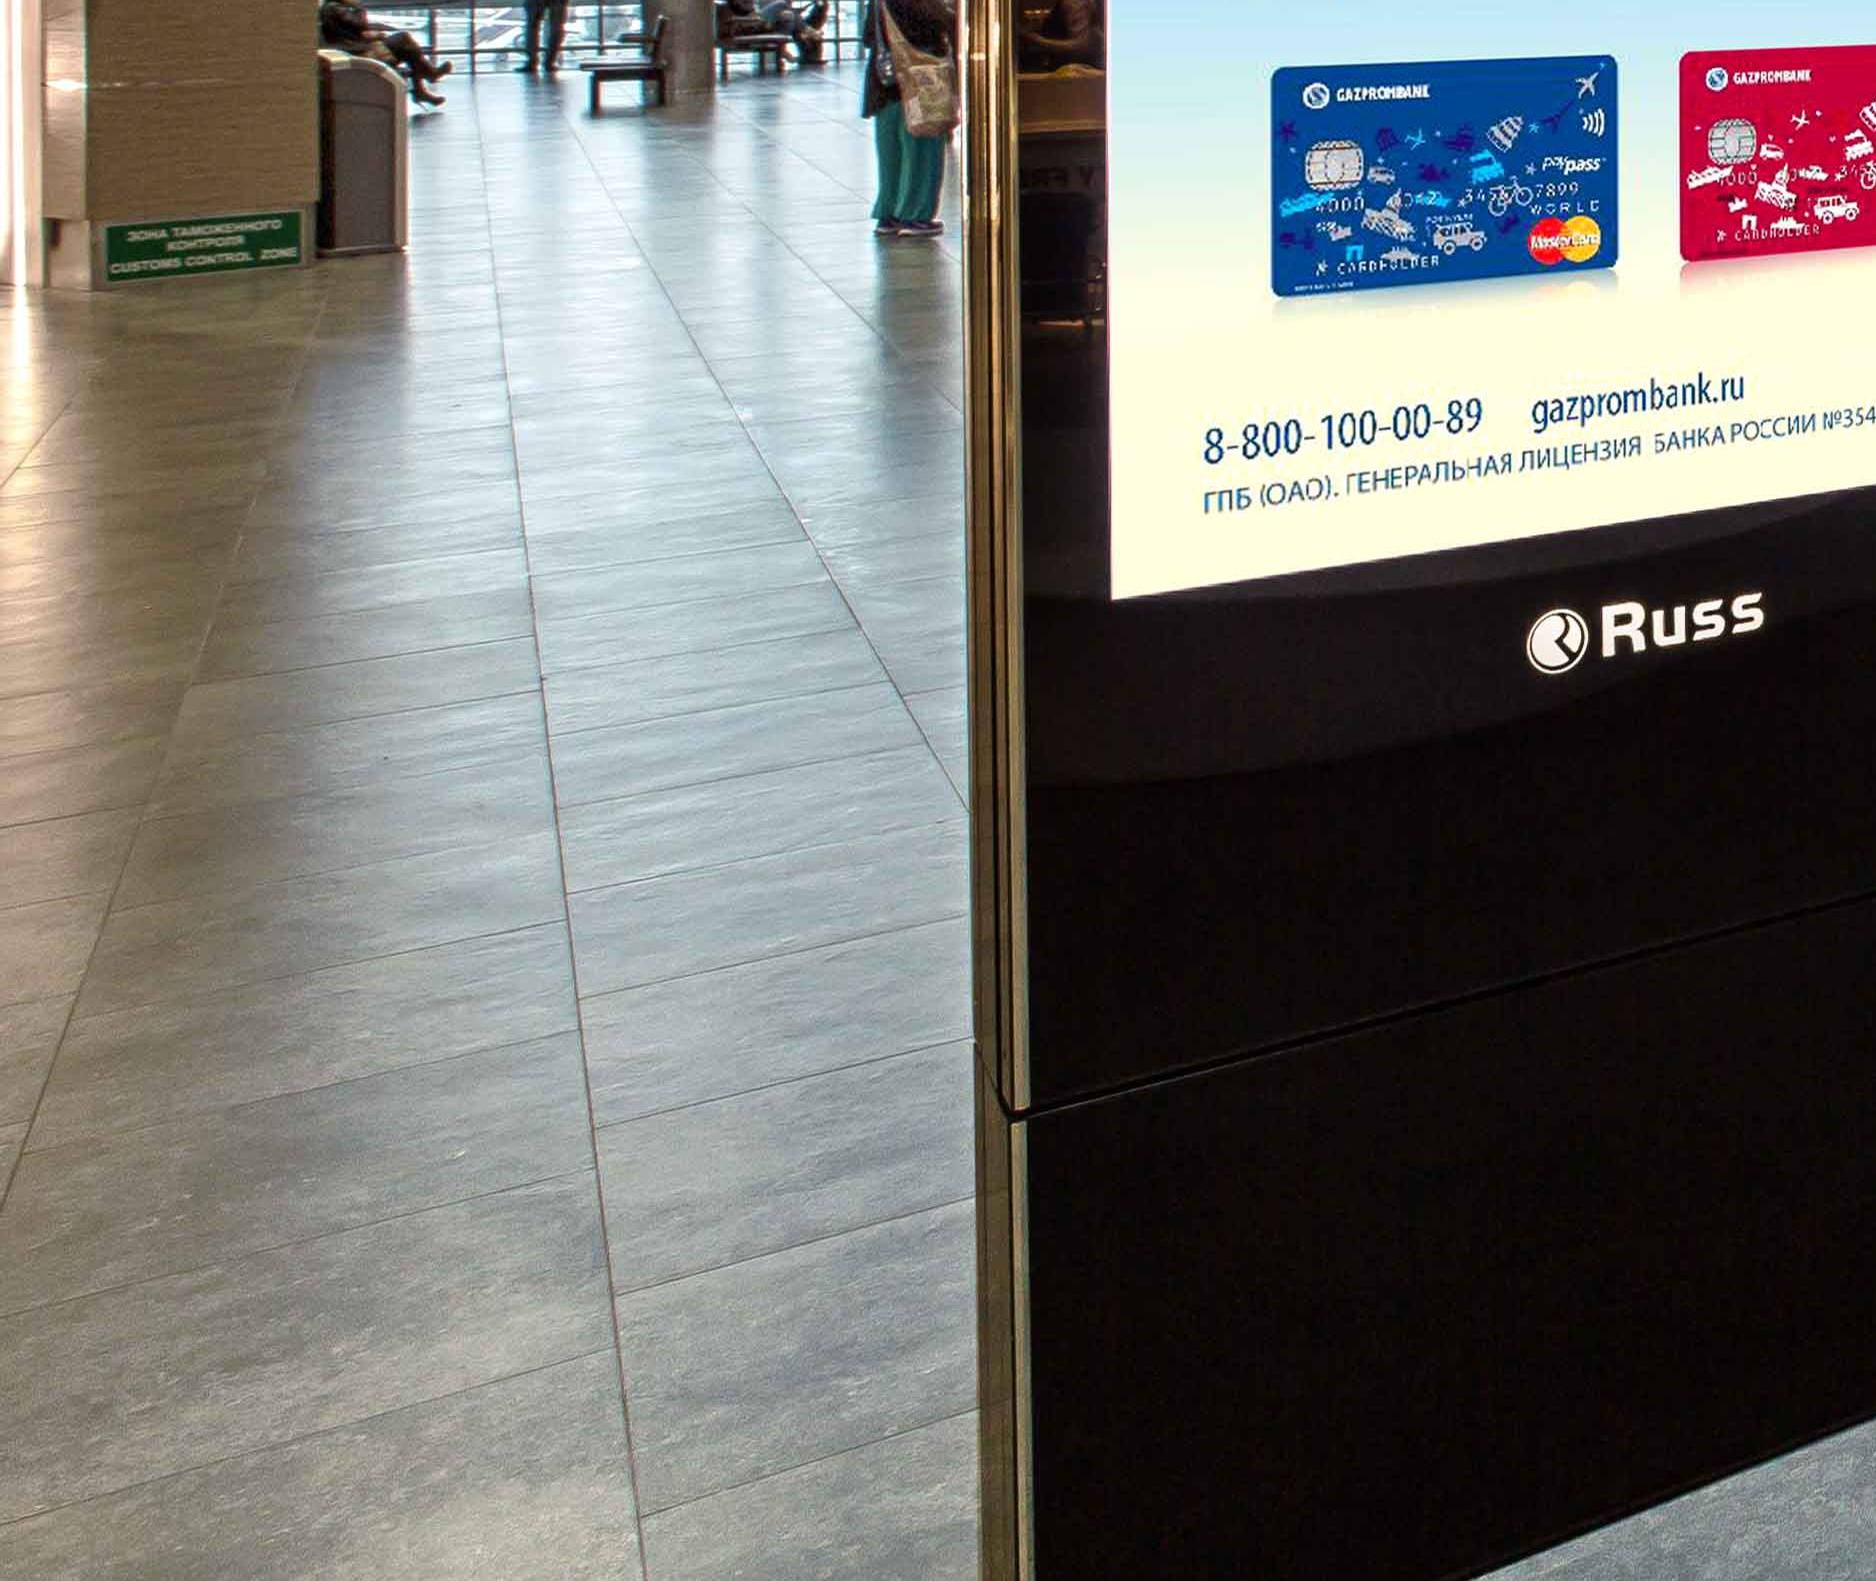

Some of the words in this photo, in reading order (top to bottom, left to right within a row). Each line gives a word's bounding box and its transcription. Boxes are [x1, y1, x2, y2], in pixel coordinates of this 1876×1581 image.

[1336, 83, 1431, 102] GAZPROMBANK
[1733, 69, 1812, 85] GAZPROMBANK
[109, 257, 182, 274] CUSTOMS
[184, 252, 254, 267] CONTROL
[260, 246, 297, 260] ZONE
[1203, 397, 1483, 465] 8-800-100-00-89
[1531, 372, 1744, 434] gazprombank.ru
[1204, 488, 1251, 515] ГПБ
[1260, 473, 1340, 508] (ОАО).
[1346, 452, 1513, 495] ГЕНЕРАЛЬНАЯ
[1519, 435, 1642, 473] ЛИЦЕНЗИЯ
[1654, 425, 1725, 454] БАНКА
[1730, 414, 1816, 446] РОССИИ
[1601, 591, 1765, 657] Russ
